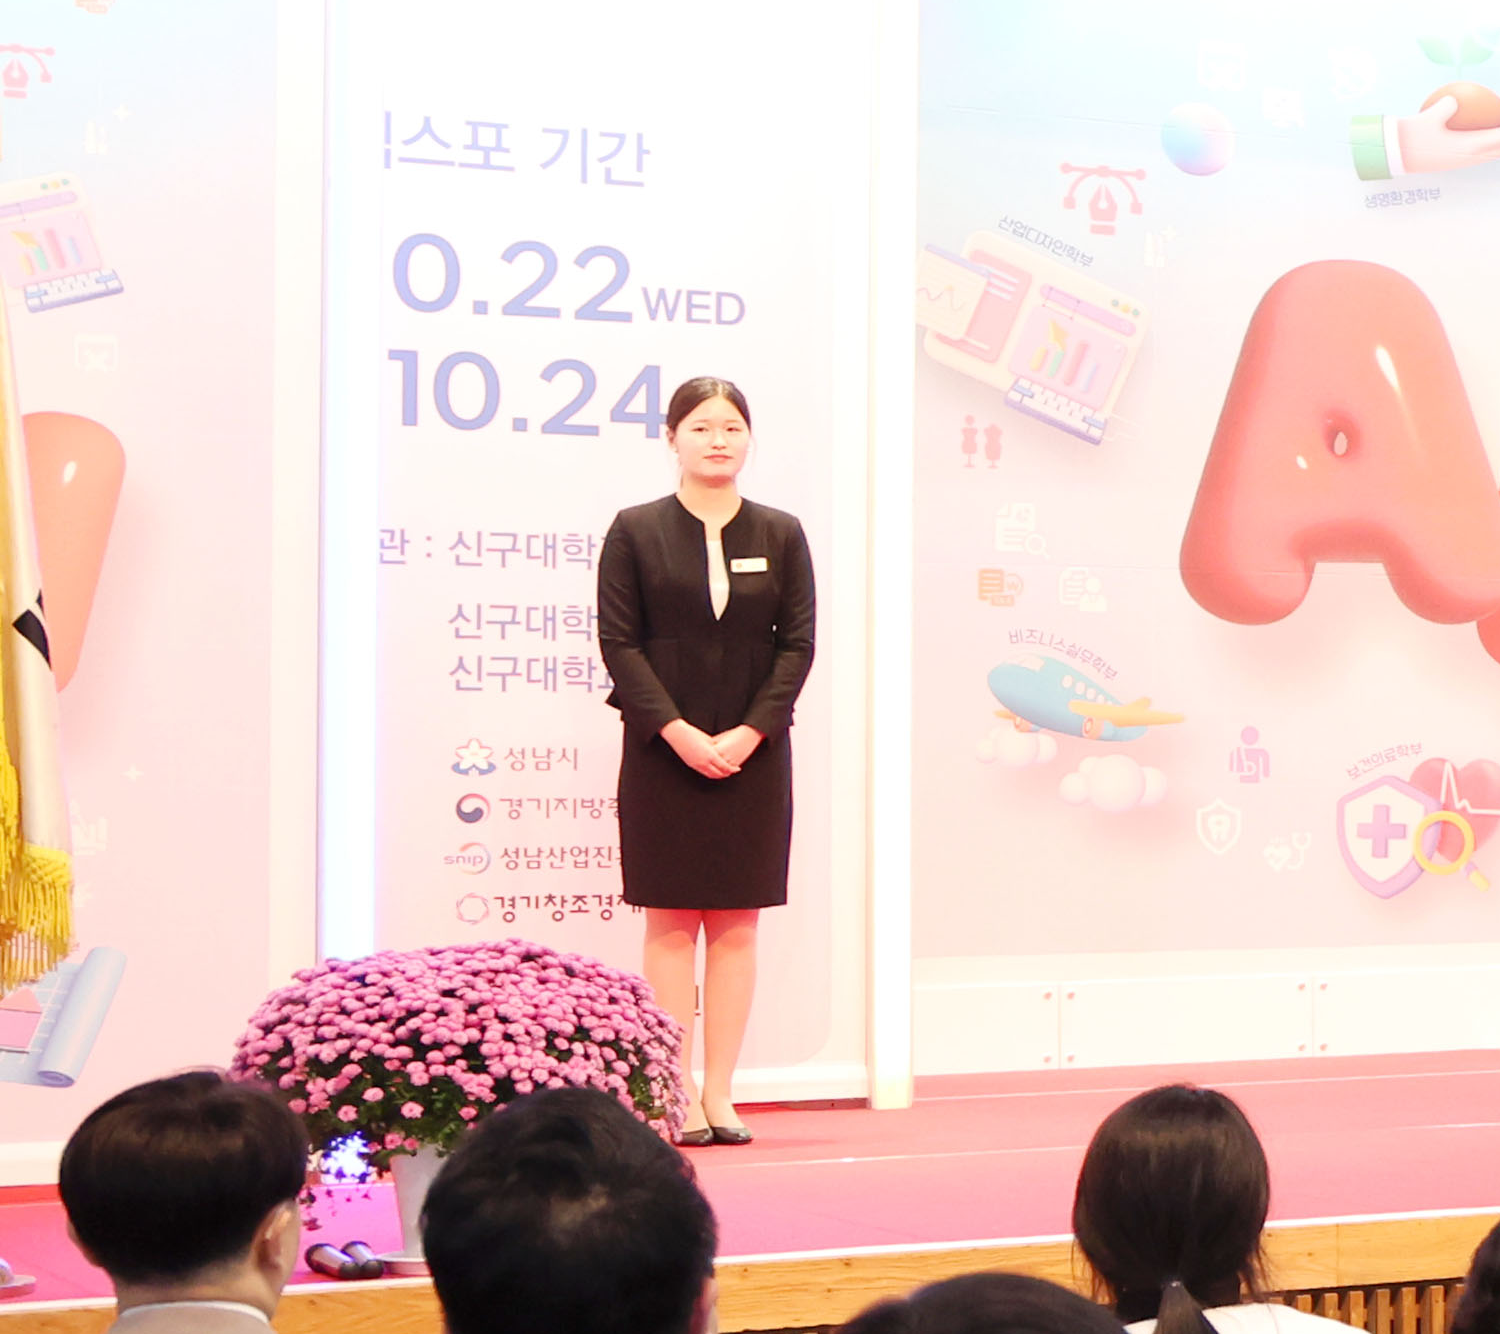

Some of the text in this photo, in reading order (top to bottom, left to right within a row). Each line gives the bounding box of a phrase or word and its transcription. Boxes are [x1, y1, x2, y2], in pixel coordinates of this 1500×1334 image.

[538, 127, 651, 188] 기간
[379, 528, 411, 565] 관
[448, 530, 607, 570] 신구대학
[448, 603, 599, 642] 신구대학
[503, 747, 579, 772] 성남시
[500, 846, 622, 871] 성남산업진
